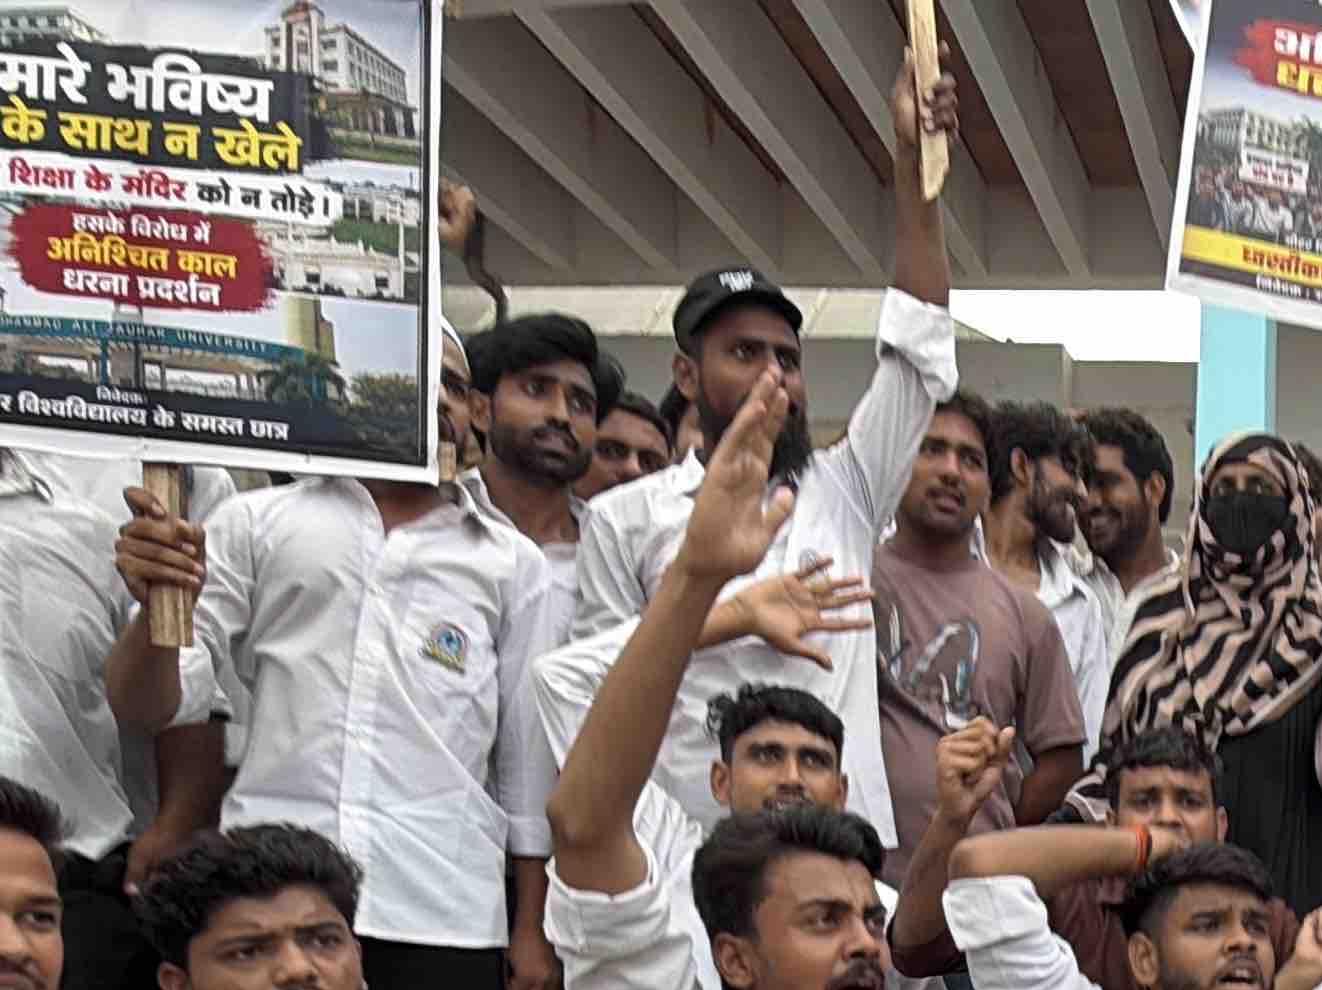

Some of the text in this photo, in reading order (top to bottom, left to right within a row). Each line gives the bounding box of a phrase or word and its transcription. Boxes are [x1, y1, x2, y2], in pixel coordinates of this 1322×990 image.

[0, 41, 274, 123] मारे भविष्य
[0, 94, 303, 171] के साथ न खेले
[9, 156, 76, 190] शिक्षा
[84, 164, 112, 192] के
[121, 167, 189, 202] मंदिर
[196, 176, 232, 206] को
[238, 185, 262, 210] न
[72, 212, 212, 245] इसके विरोध में
[47, 231, 238, 280] अनिश्चित काल
[63, 267, 222, 306] धरना प्रदर्शन
[18, 389, 148, 427] विश्वविद्यालय
[153, 404, 176, 428] के
[181, 411, 246, 436] समस्त
[250, 419, 289, 440] छात्र
